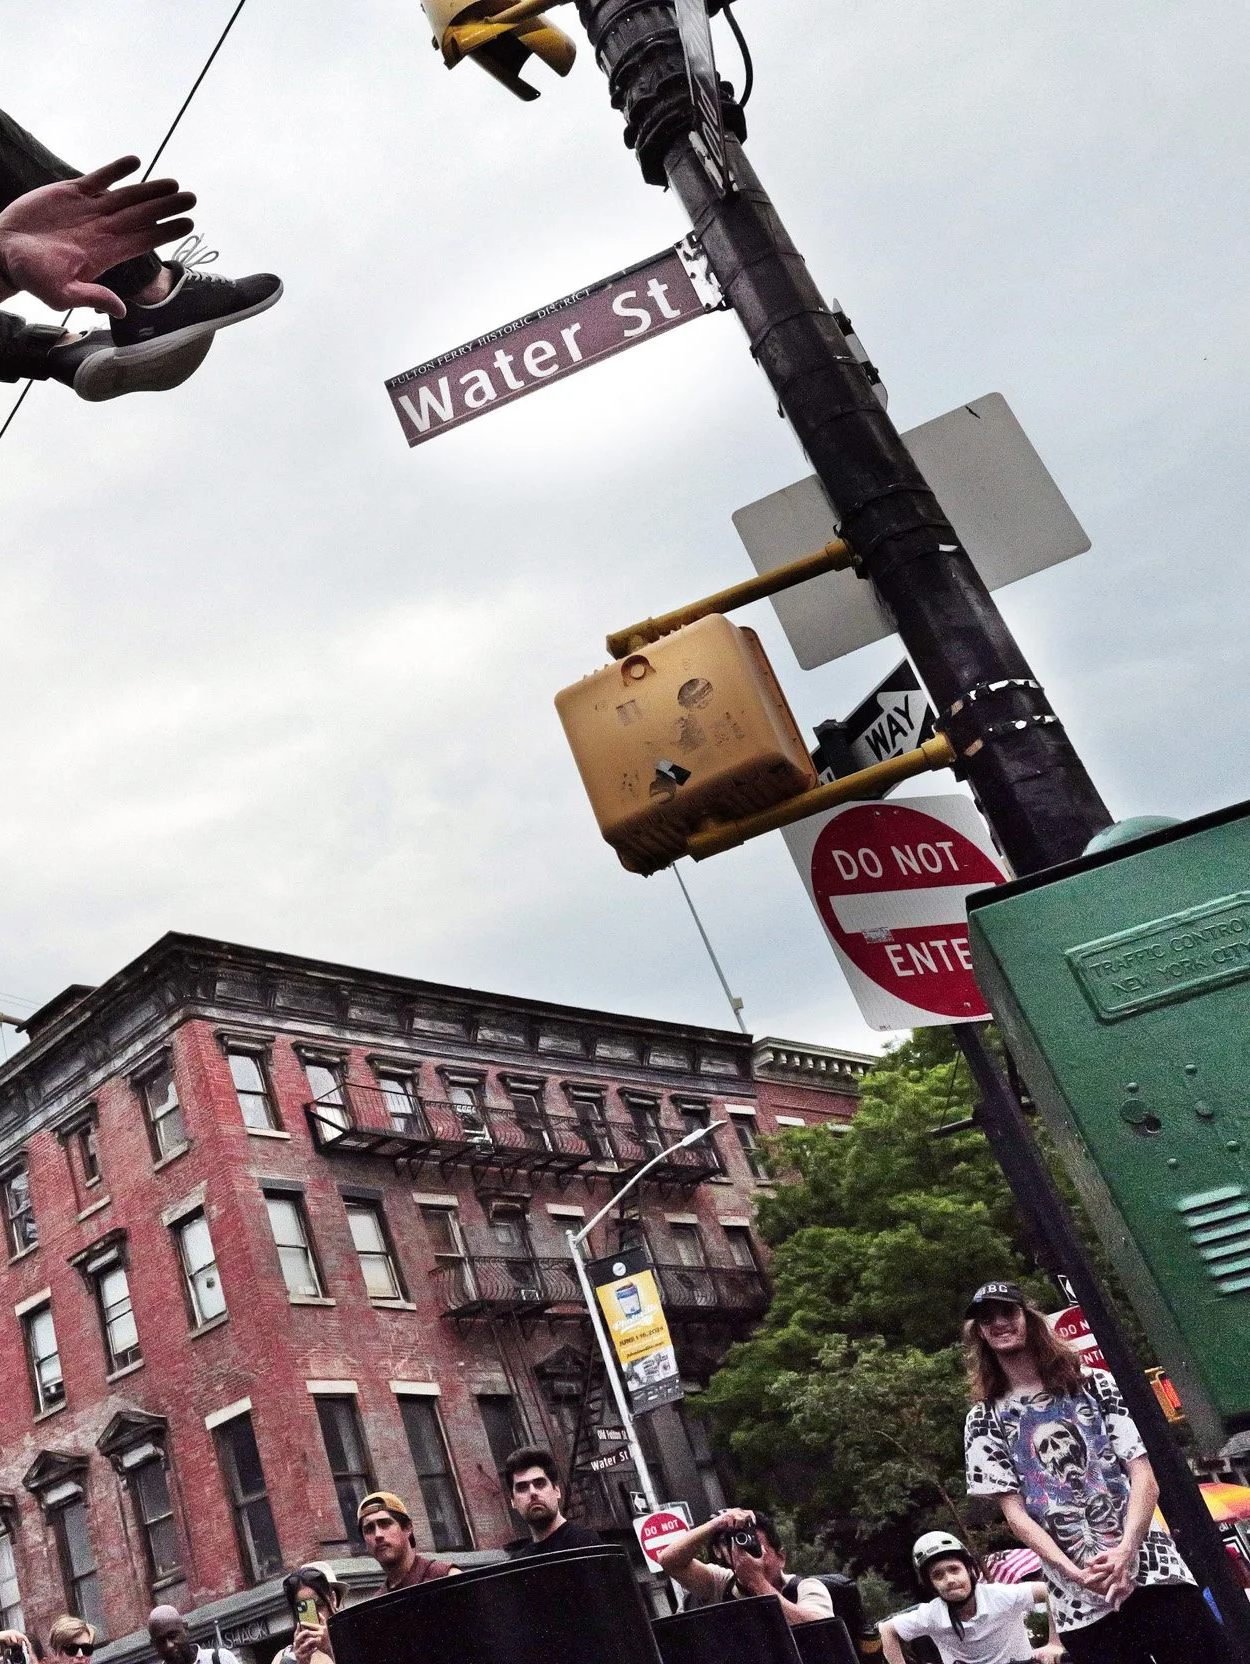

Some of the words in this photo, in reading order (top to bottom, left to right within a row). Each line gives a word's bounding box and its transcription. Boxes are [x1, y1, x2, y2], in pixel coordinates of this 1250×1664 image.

[390, 361, 436, 387] FULTON
[437, 342, 474, 367] FERRY
[477, 315, 533, 347] HISTORIC
[536, 287, 591, 320] DISTRICT
[398, 322, 582, 433] Water
[611, 277, 681, 338] St
[865, 694, 915, 762] WAY
[831, 847, 883, 881] DO
[890, 841, 959, 876] NOT
[885, 938, 974, 977] ENTE
[1089, 943, 1165, 978] TRAFFIC
[1112, 974, 1150, 995] NEW
[1156, 957, 1209, 978] YORK
[1059, 1324, 1077, 1338] DO
[590, 1455, 617, 1471] Water
[619, 1450, 629, 1462] St
[644, 1526, 657, 1537] DO
[661, 1519, 679, 1532] NOT
